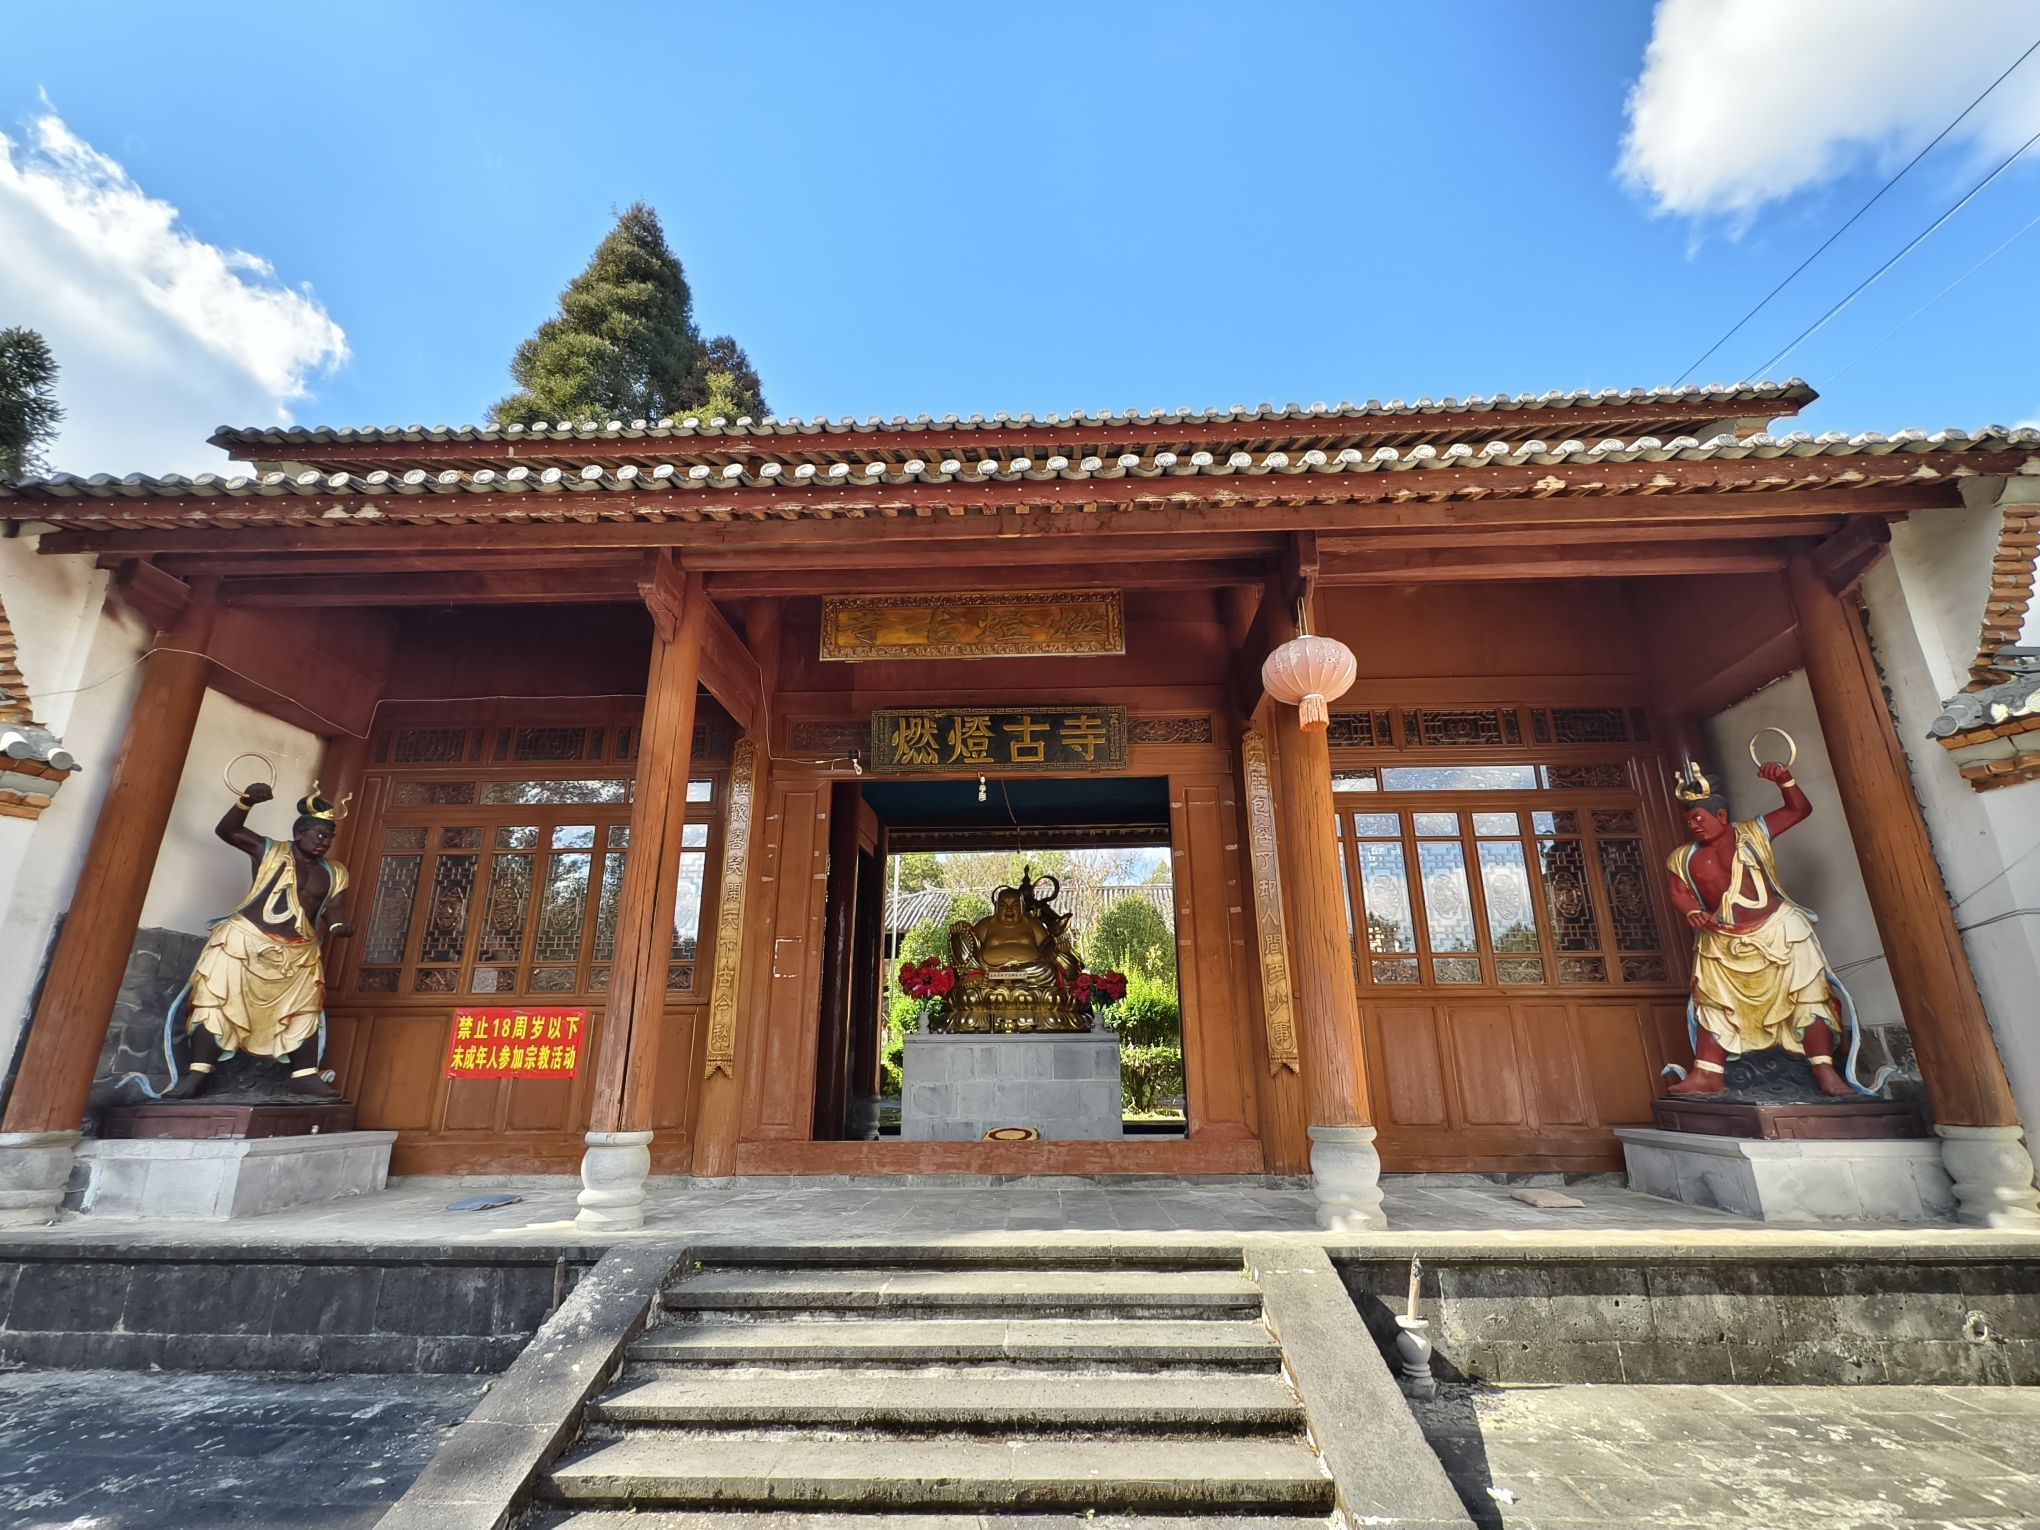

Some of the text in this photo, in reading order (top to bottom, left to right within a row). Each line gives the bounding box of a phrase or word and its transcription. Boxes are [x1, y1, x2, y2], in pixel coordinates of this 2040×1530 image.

[891, 715, 1106, 764] 燃燈古寺
[457, 1015, 580, 1040] 禁止18周岁以下
[451, 1045, 576, 1070] 未成年人参加宗教活动
